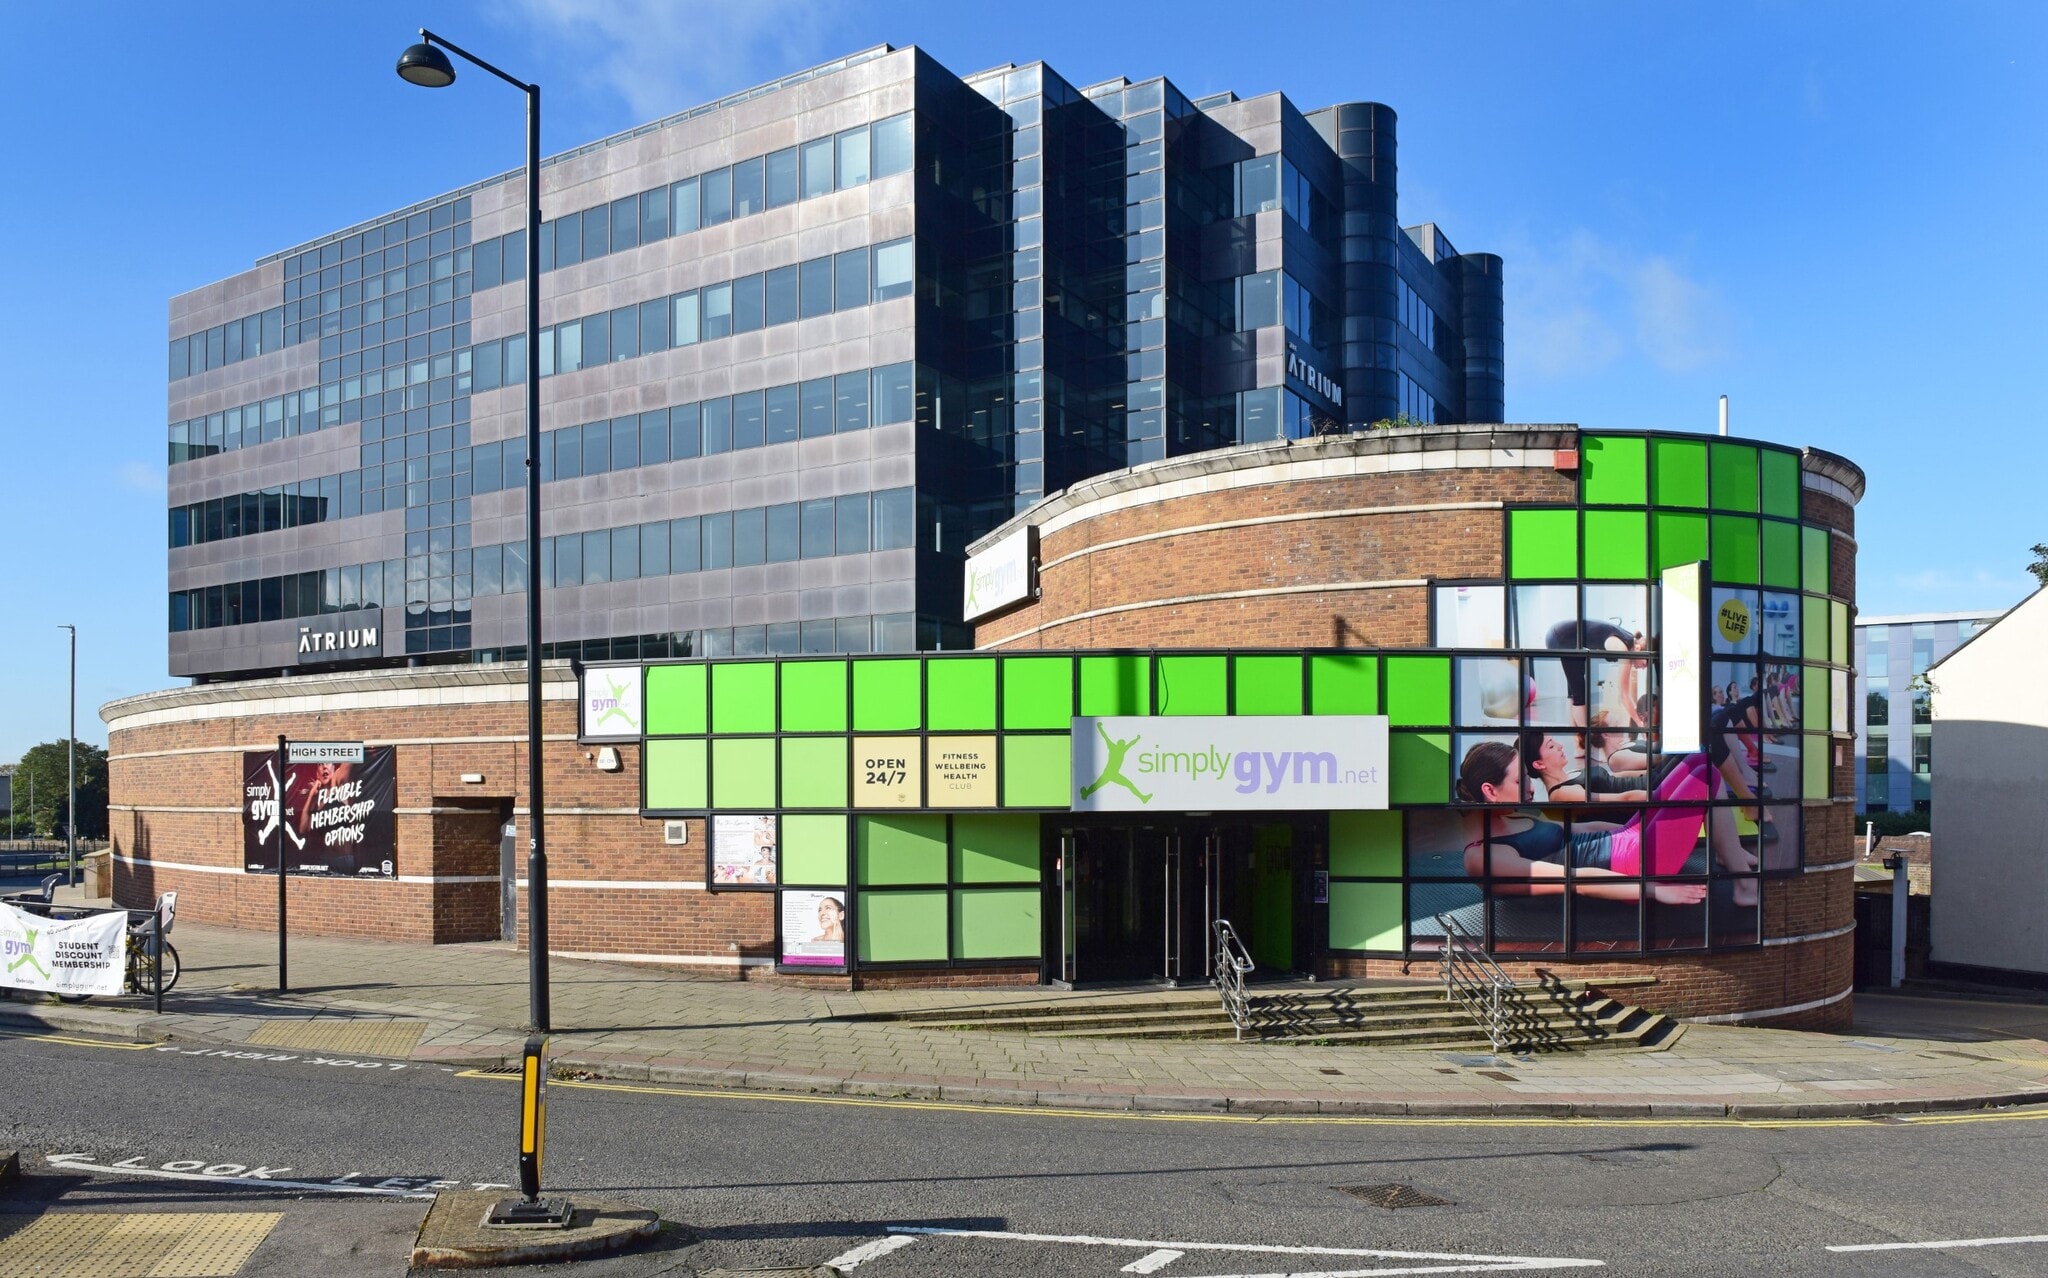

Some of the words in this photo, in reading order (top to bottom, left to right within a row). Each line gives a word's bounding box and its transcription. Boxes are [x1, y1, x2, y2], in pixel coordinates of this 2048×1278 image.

[1288, 353, 1342, 407] ATRIUM
[1721, 608, 1748, 625] #LIVE
[1726, 620, 1746, 634] LIFE
[299, 627, 377, 653] ATRIUM
[592, 698, 618, 711] gym
[291, 748, 317, 757] HIGH
[320, 748, 361, 757] STREET
[865, 759, 906, 769] OPEN
[866, 770, 907, 786] 24/7
[246, 782, 271, 799] simply
[317, 780, 363, 806] FLEXIBLE
[310, 799, 375, 830] MEMBERSHIP
[324, 823, 366, 847] OPTIONS
[530, 838, 537, 850] 5
[5, 940, 32, 956] gym
[58, 942, 99, 950] STUDENT
[52, 961, 110, 969] MEMBERSHIP
[180, 1049, 299, 1061] RIGHT
[302, 1057, 408, 1070] LOOK
[112, 1156, 292, 1179] LOOK
[331, 1172, 512, 1192] LEFT
